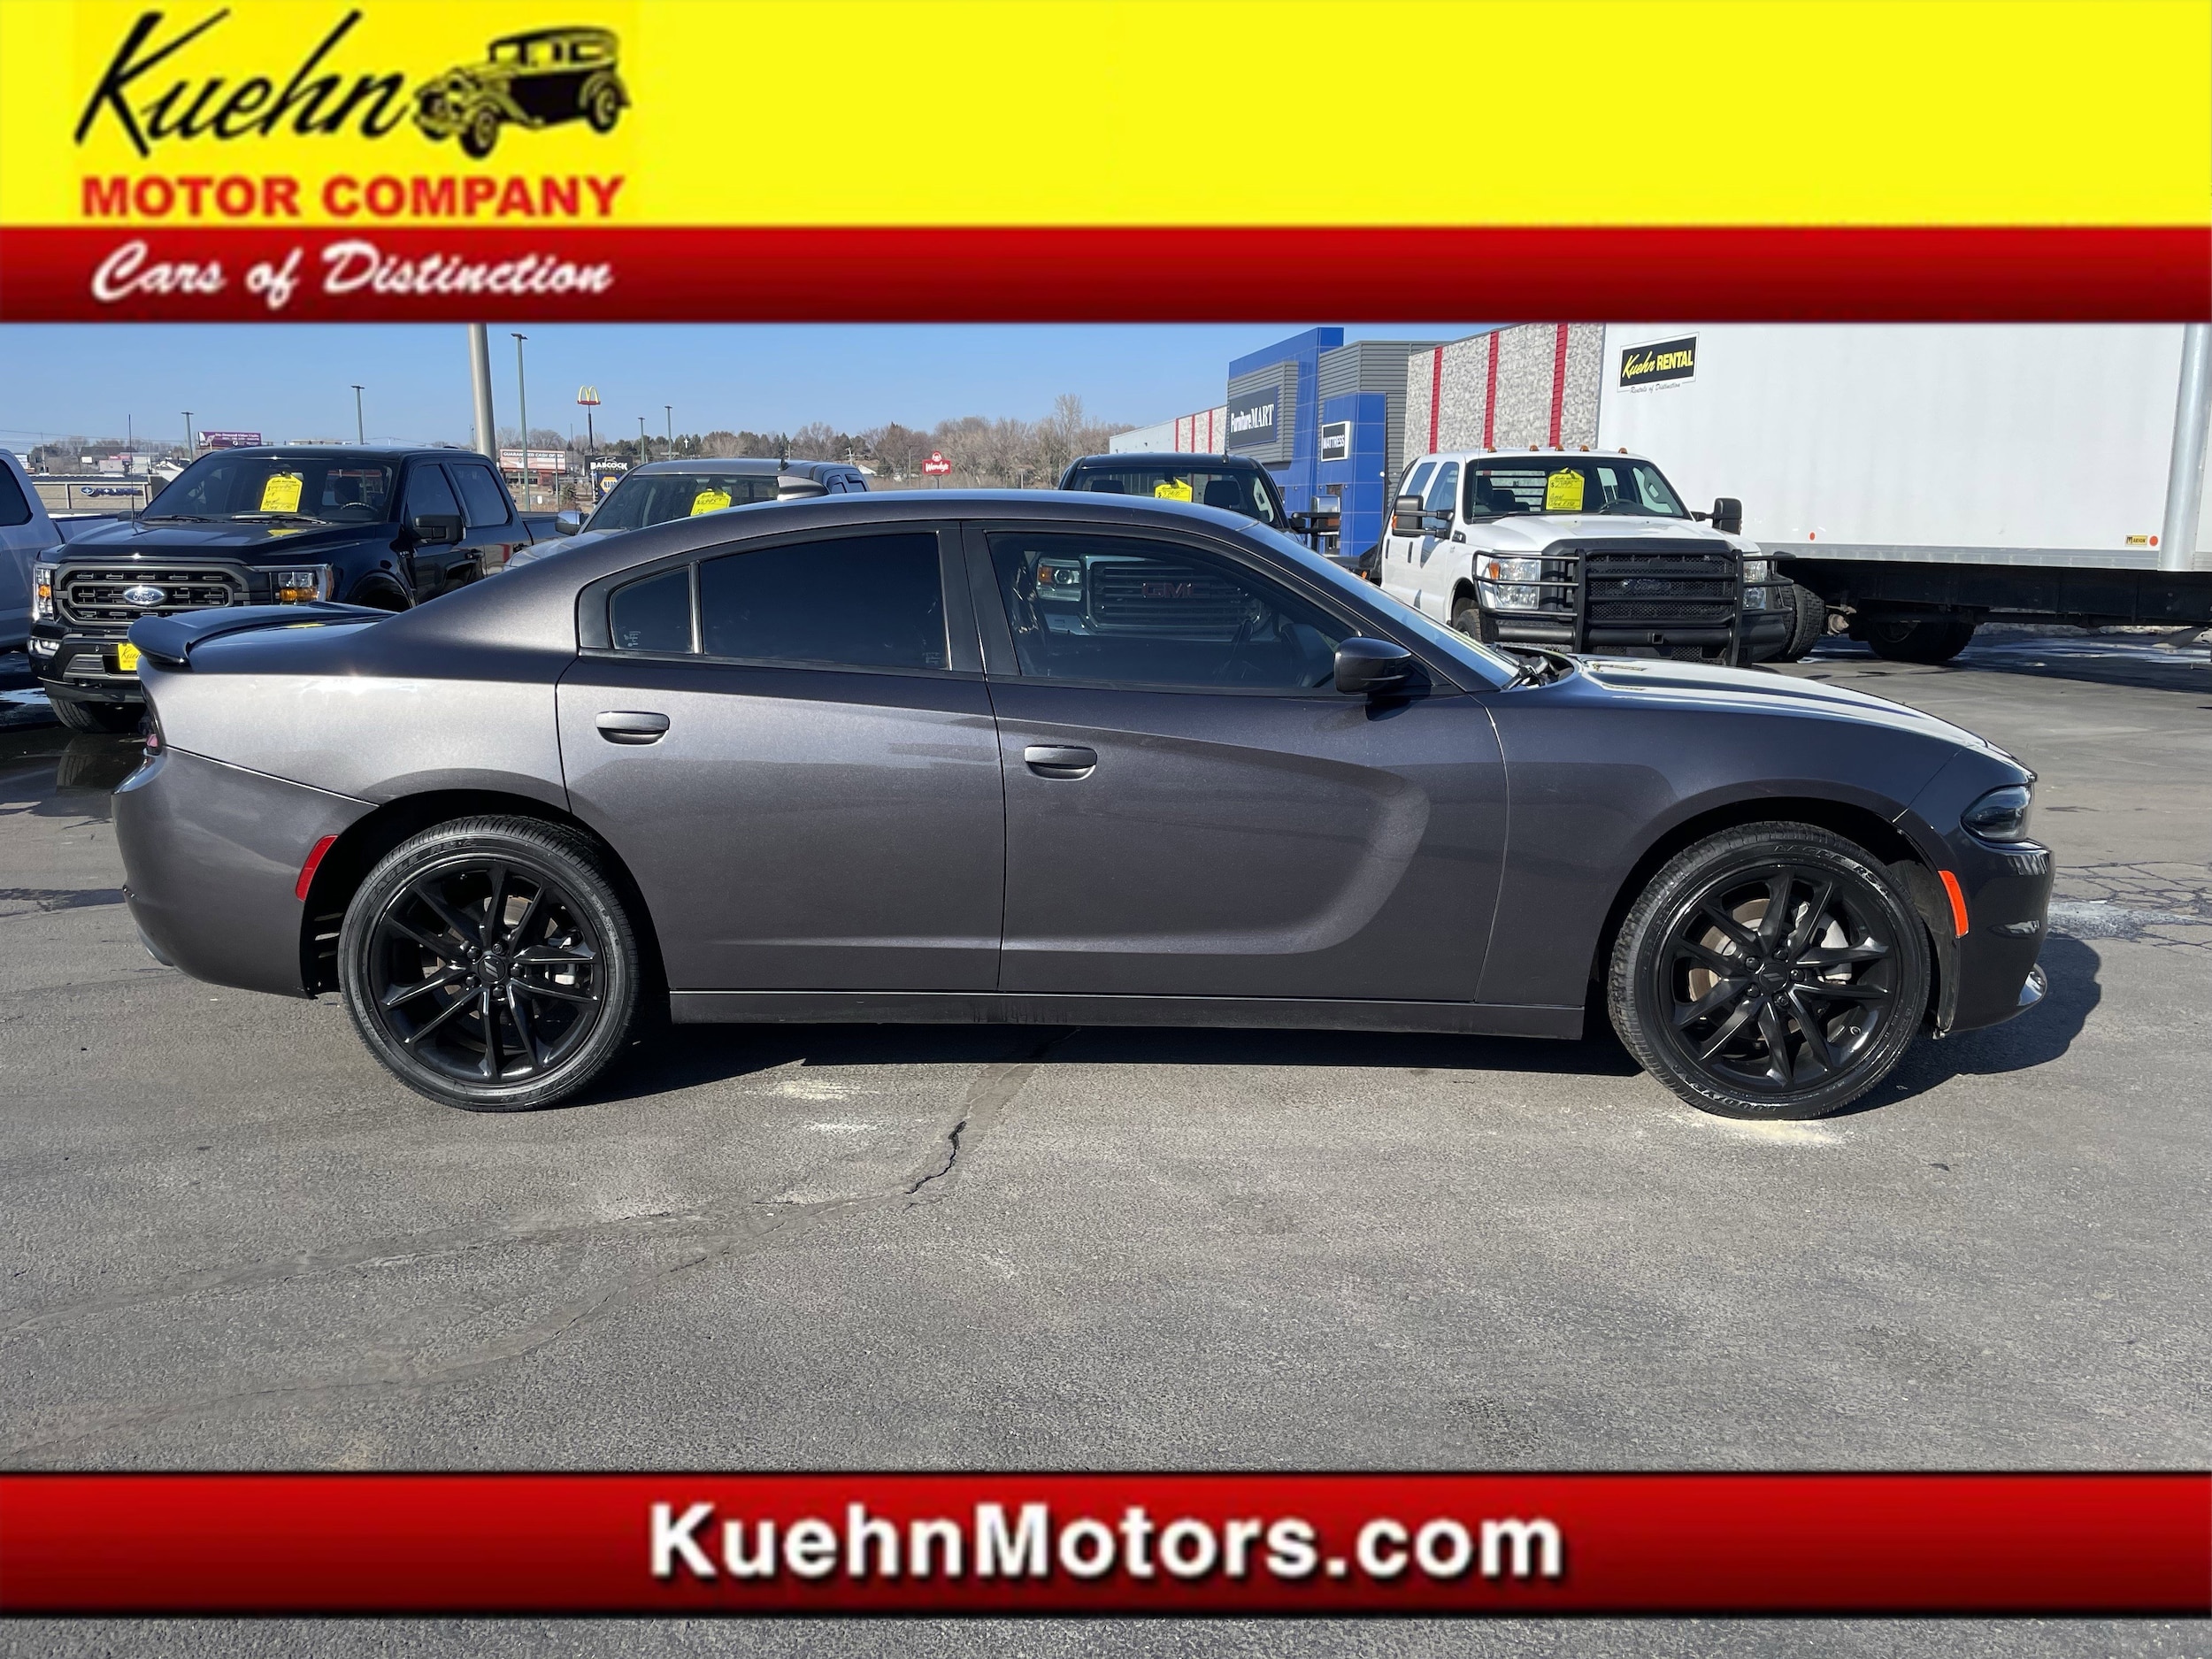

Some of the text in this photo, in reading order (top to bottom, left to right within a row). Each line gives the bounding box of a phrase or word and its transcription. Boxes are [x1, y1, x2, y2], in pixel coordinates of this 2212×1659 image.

[1621, 349, 1694, 379] Kuehn RENTAL
[1323, 434, 1345, 449] MATTRESS
[590, 462, 627, 471] BABCOCK
[133, 589, 155, 601] Ford
